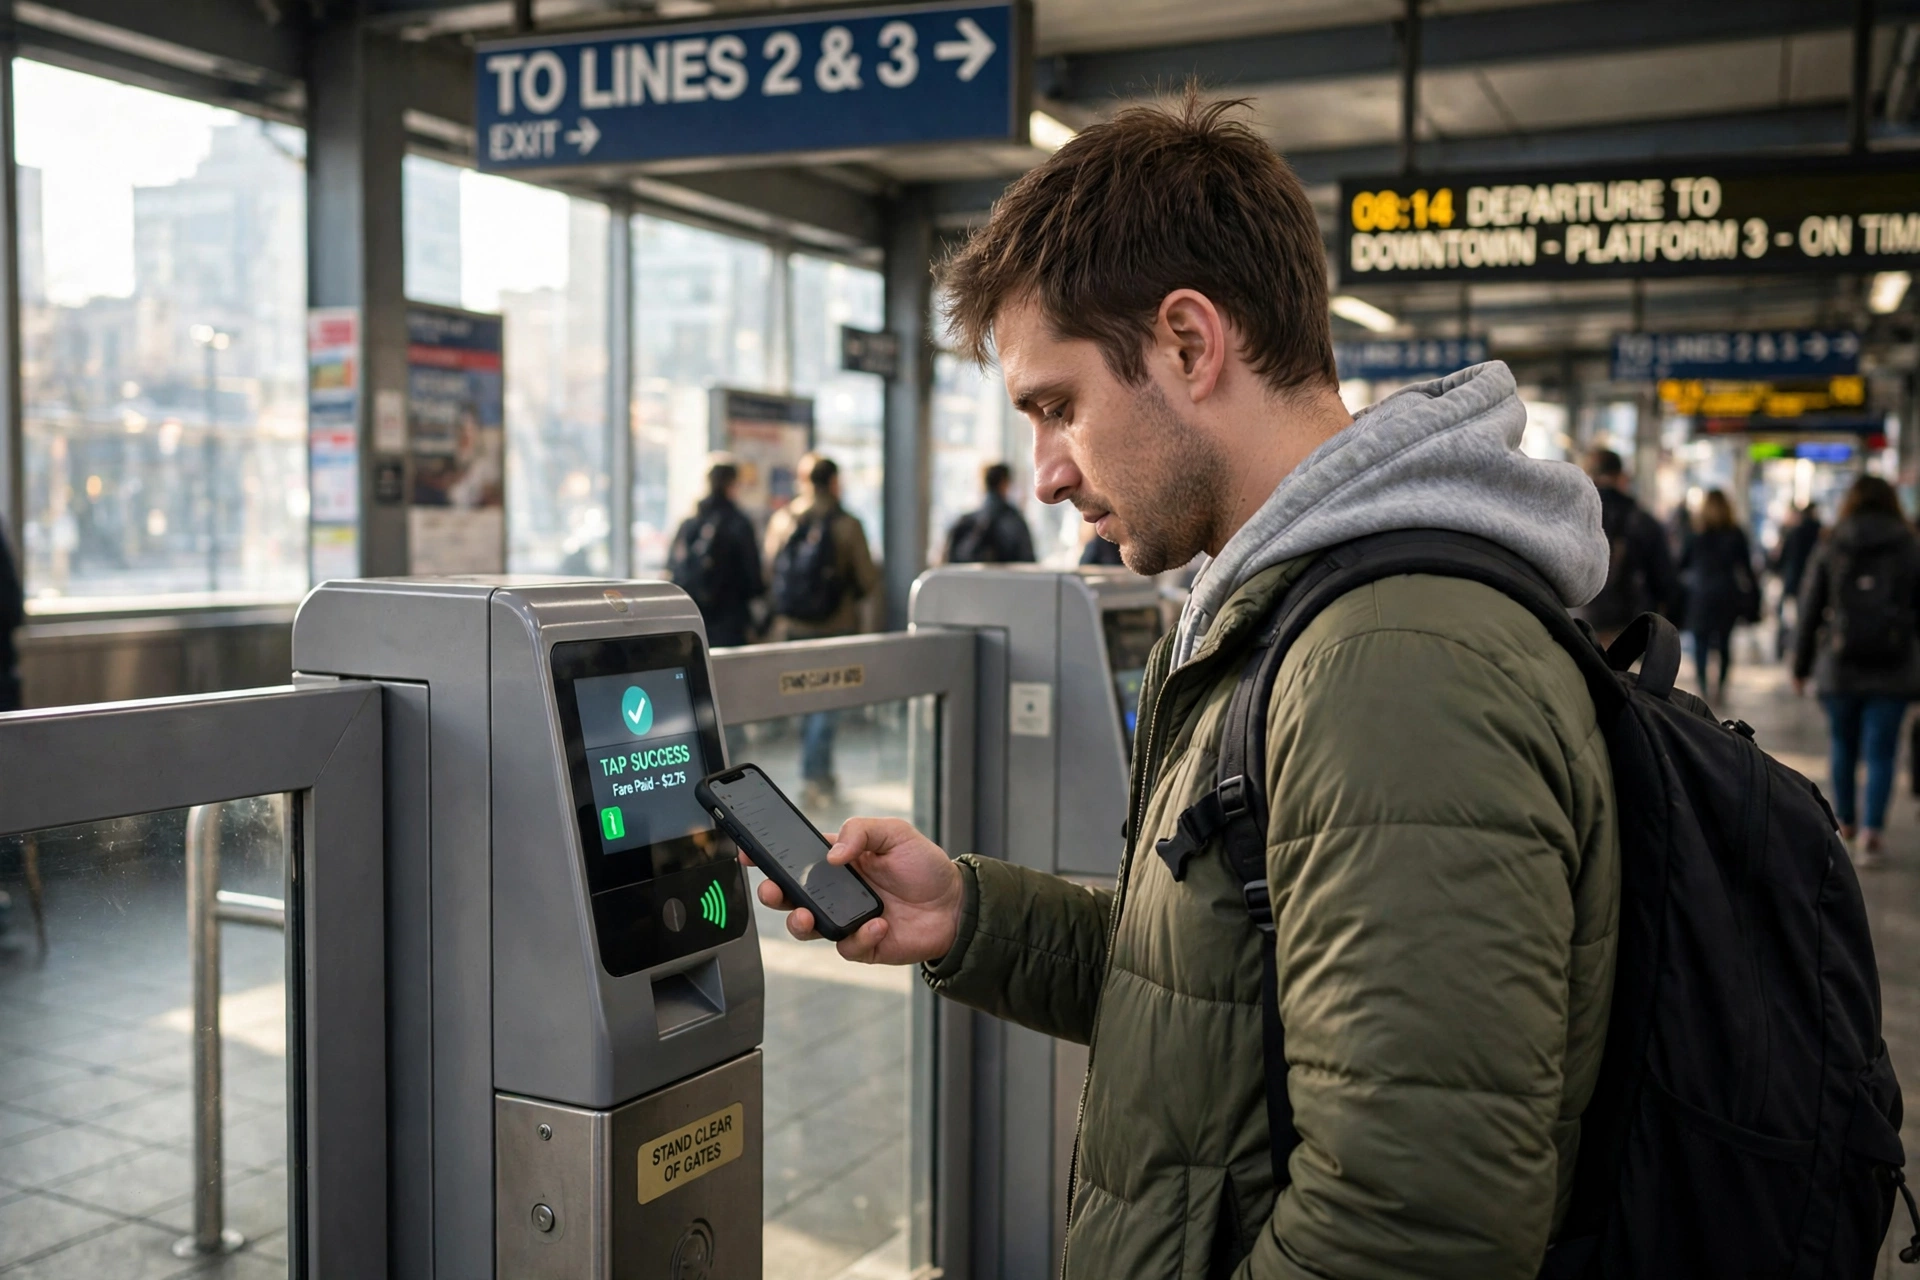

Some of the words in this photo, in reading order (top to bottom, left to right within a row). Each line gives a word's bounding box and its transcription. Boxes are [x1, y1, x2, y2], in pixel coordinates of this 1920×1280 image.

[487, 50, 566, 115] TO
[580, 35, 747, 110] LINES
[762, 31, 801, 96] 2
[815, 26, 863, 93] &
[877, 20, 919, 88] 3
[489, 120, 561, 160] EXIT
[1352, 188, 1455, 231] 08:14
[1467, 179, 1664, 226] DEPARTURE
[1671, 177, 1721, 218] TO
[1352, 226, 1536, 271] DOWNTOWN
[1565, 219, 1738, 264] PLATFORM
[1742, 218, 1768, 258] 3
[1799, 215, 1852, 257] ON
[1858, 212, 1920, 255] TIM
[600, 756, 627, 776] TAP
[631, 745, 690, 771] SUCCESS
[613, 783, 633, 797] Fare
[634, 776, 654, 792] Paid
[652, 1134, 692, 1166] STAND
[695, 1115, 732, 1145] CLEAR
[664, 1161, 681, 1182] OF
[684, 1142, 721, 1173] GATES
